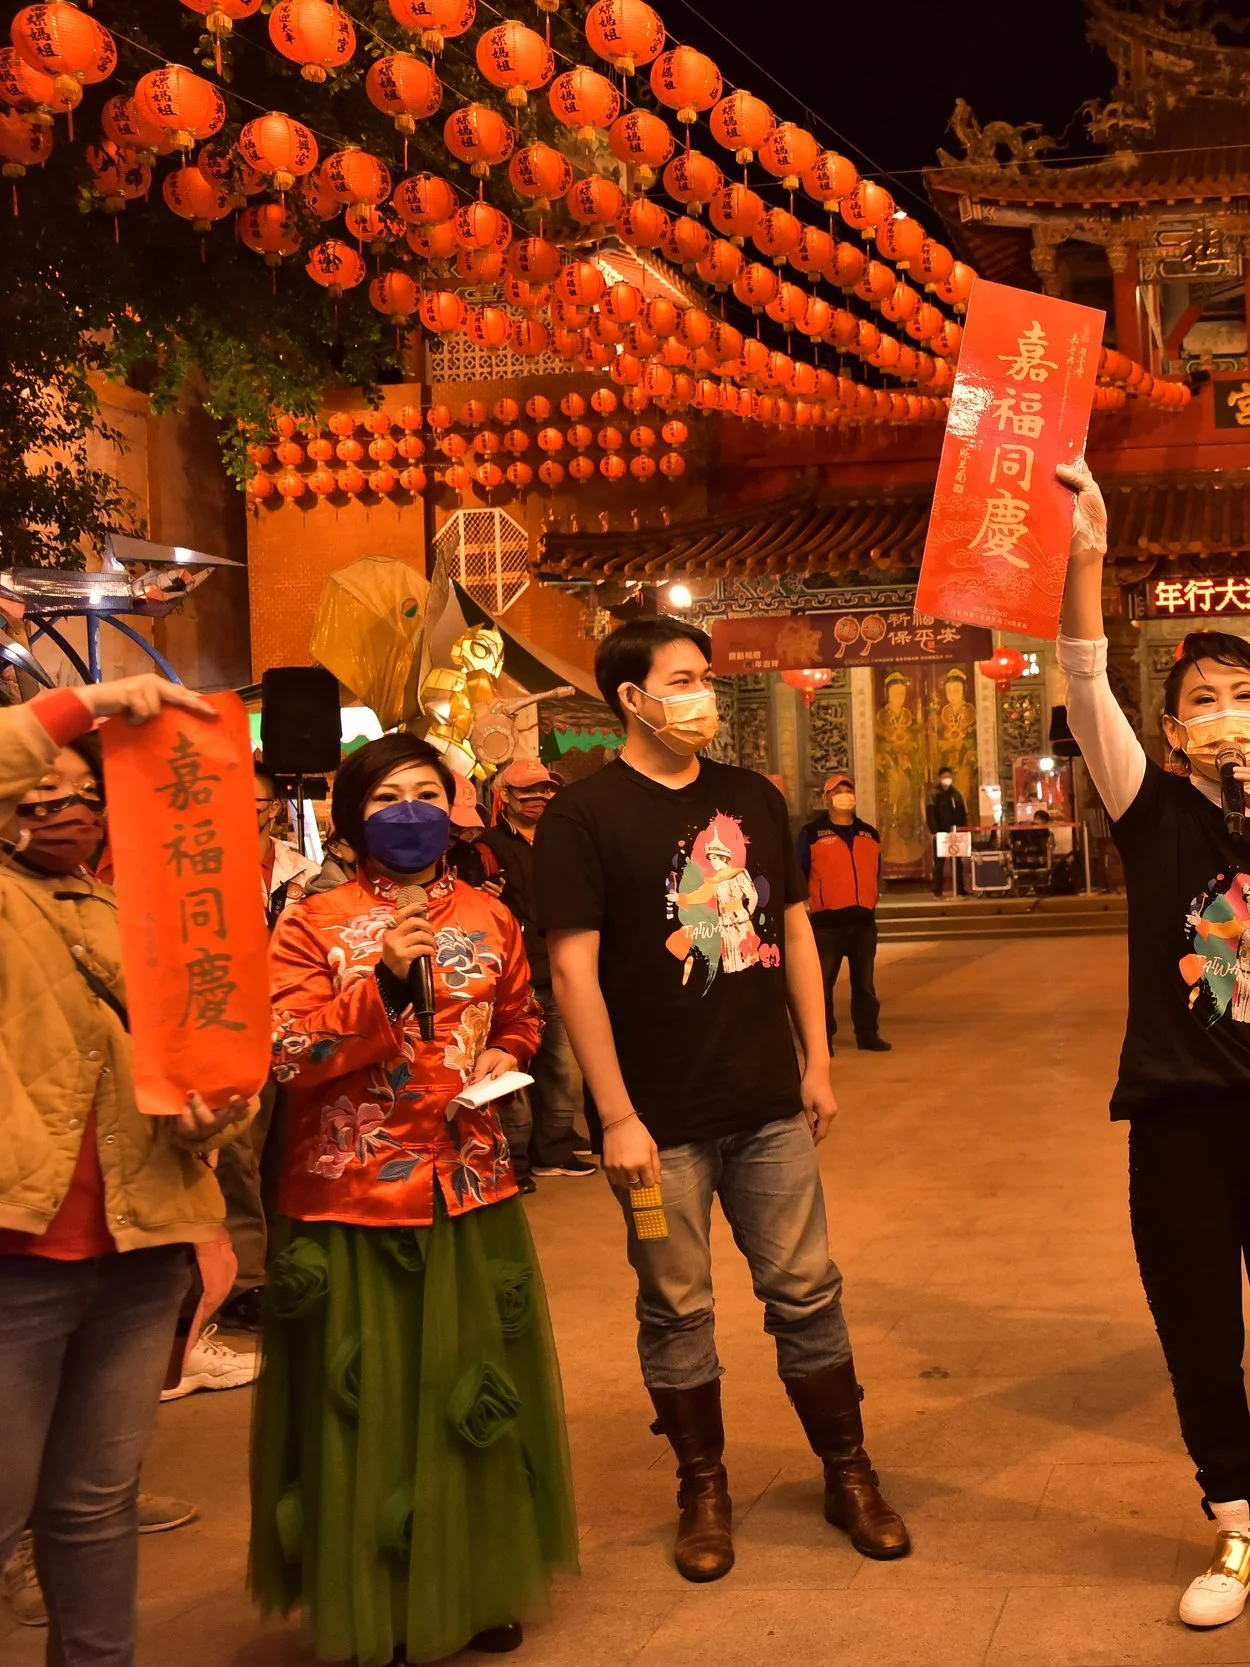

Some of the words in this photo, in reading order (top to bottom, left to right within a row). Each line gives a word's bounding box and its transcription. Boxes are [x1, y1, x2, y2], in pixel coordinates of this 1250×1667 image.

[967, 320, 1059, 570] 嘉福同慶
[887, 612, 962, 628] 祈福
[154, 730, 248, 1033] 嘉福同慶
